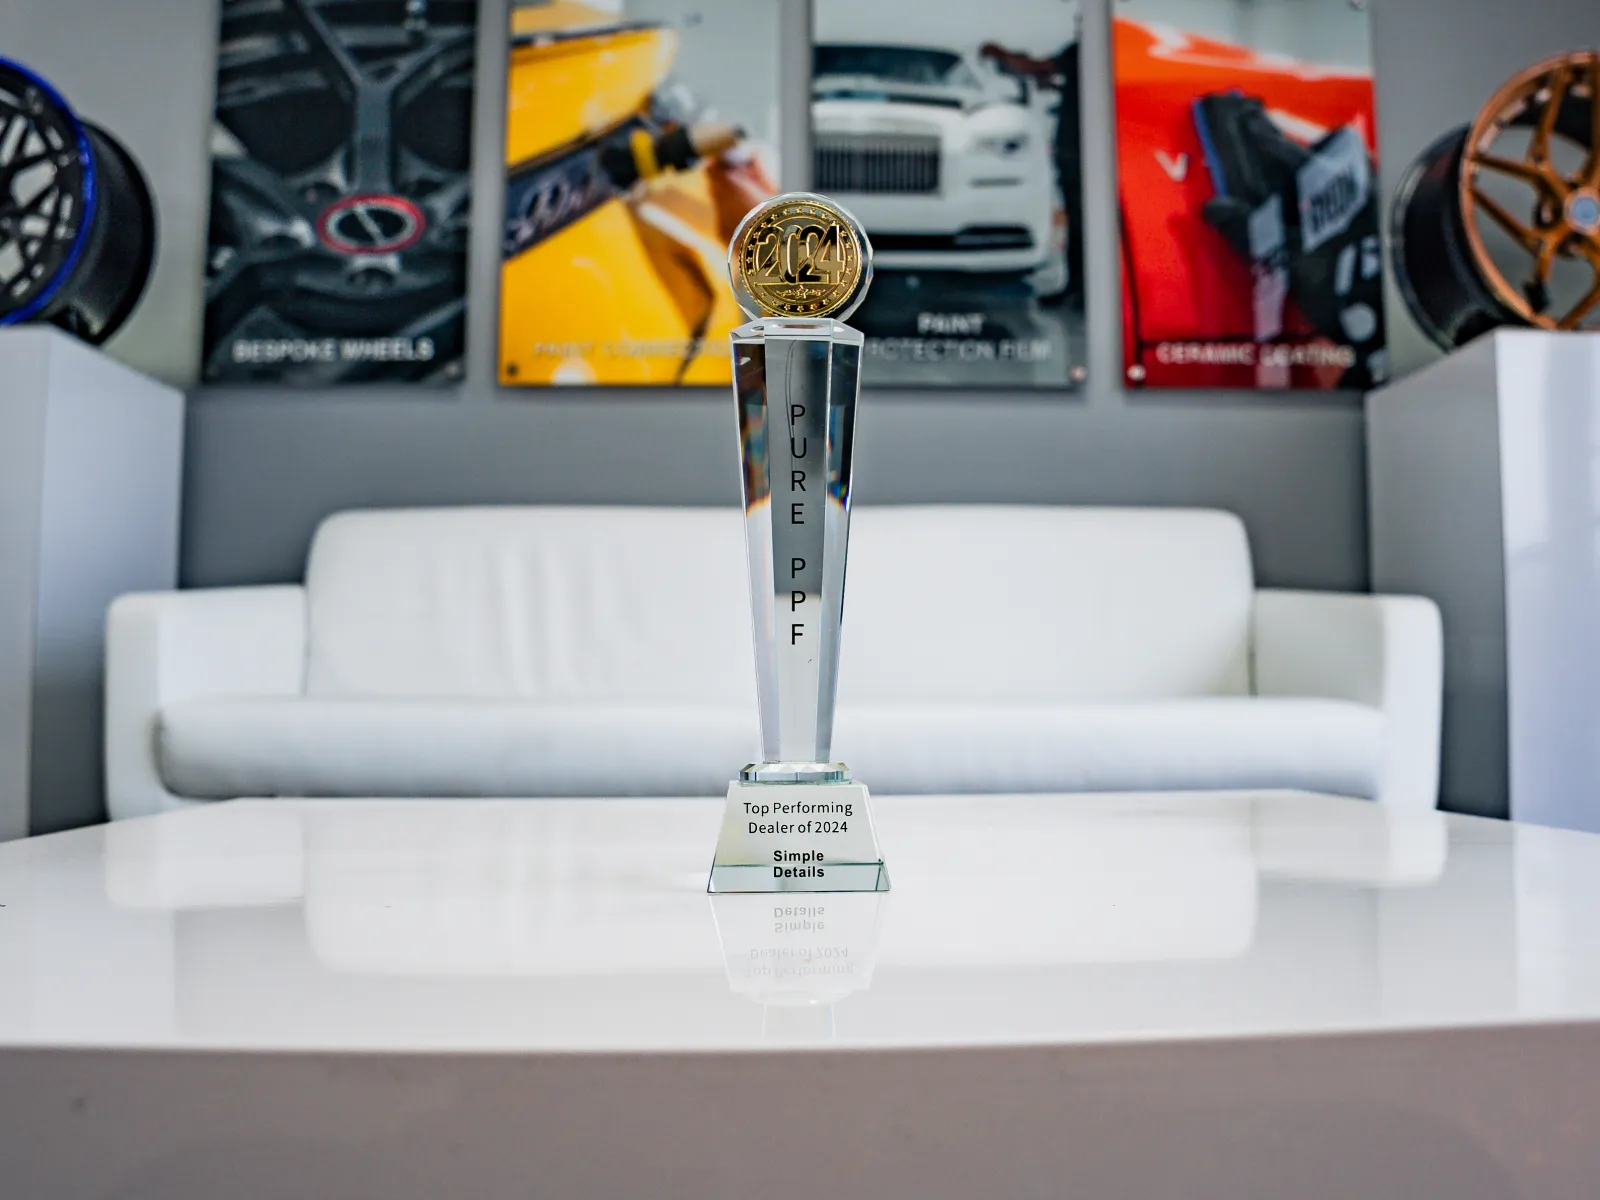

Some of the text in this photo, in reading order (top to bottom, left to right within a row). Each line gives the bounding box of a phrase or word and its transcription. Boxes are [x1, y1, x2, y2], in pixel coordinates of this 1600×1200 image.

[755, 224, 845, 285] 2024
[917, 312, 984, 335] PAINT
[232, 336, 435, 363] BESPOKE WHEELS
[864, 337, 995, 362] ROTECTION
[1155, 341, 1256, 365] CERAMIC
[790, 403, 808, 646] PURE PPF
[743, 801, 853, 817] Top Performing
[748, 821, 849, 834] Dealer of 2024
[773, 850, 825, 864] Simple
[773, 866, 825, 878] Details
